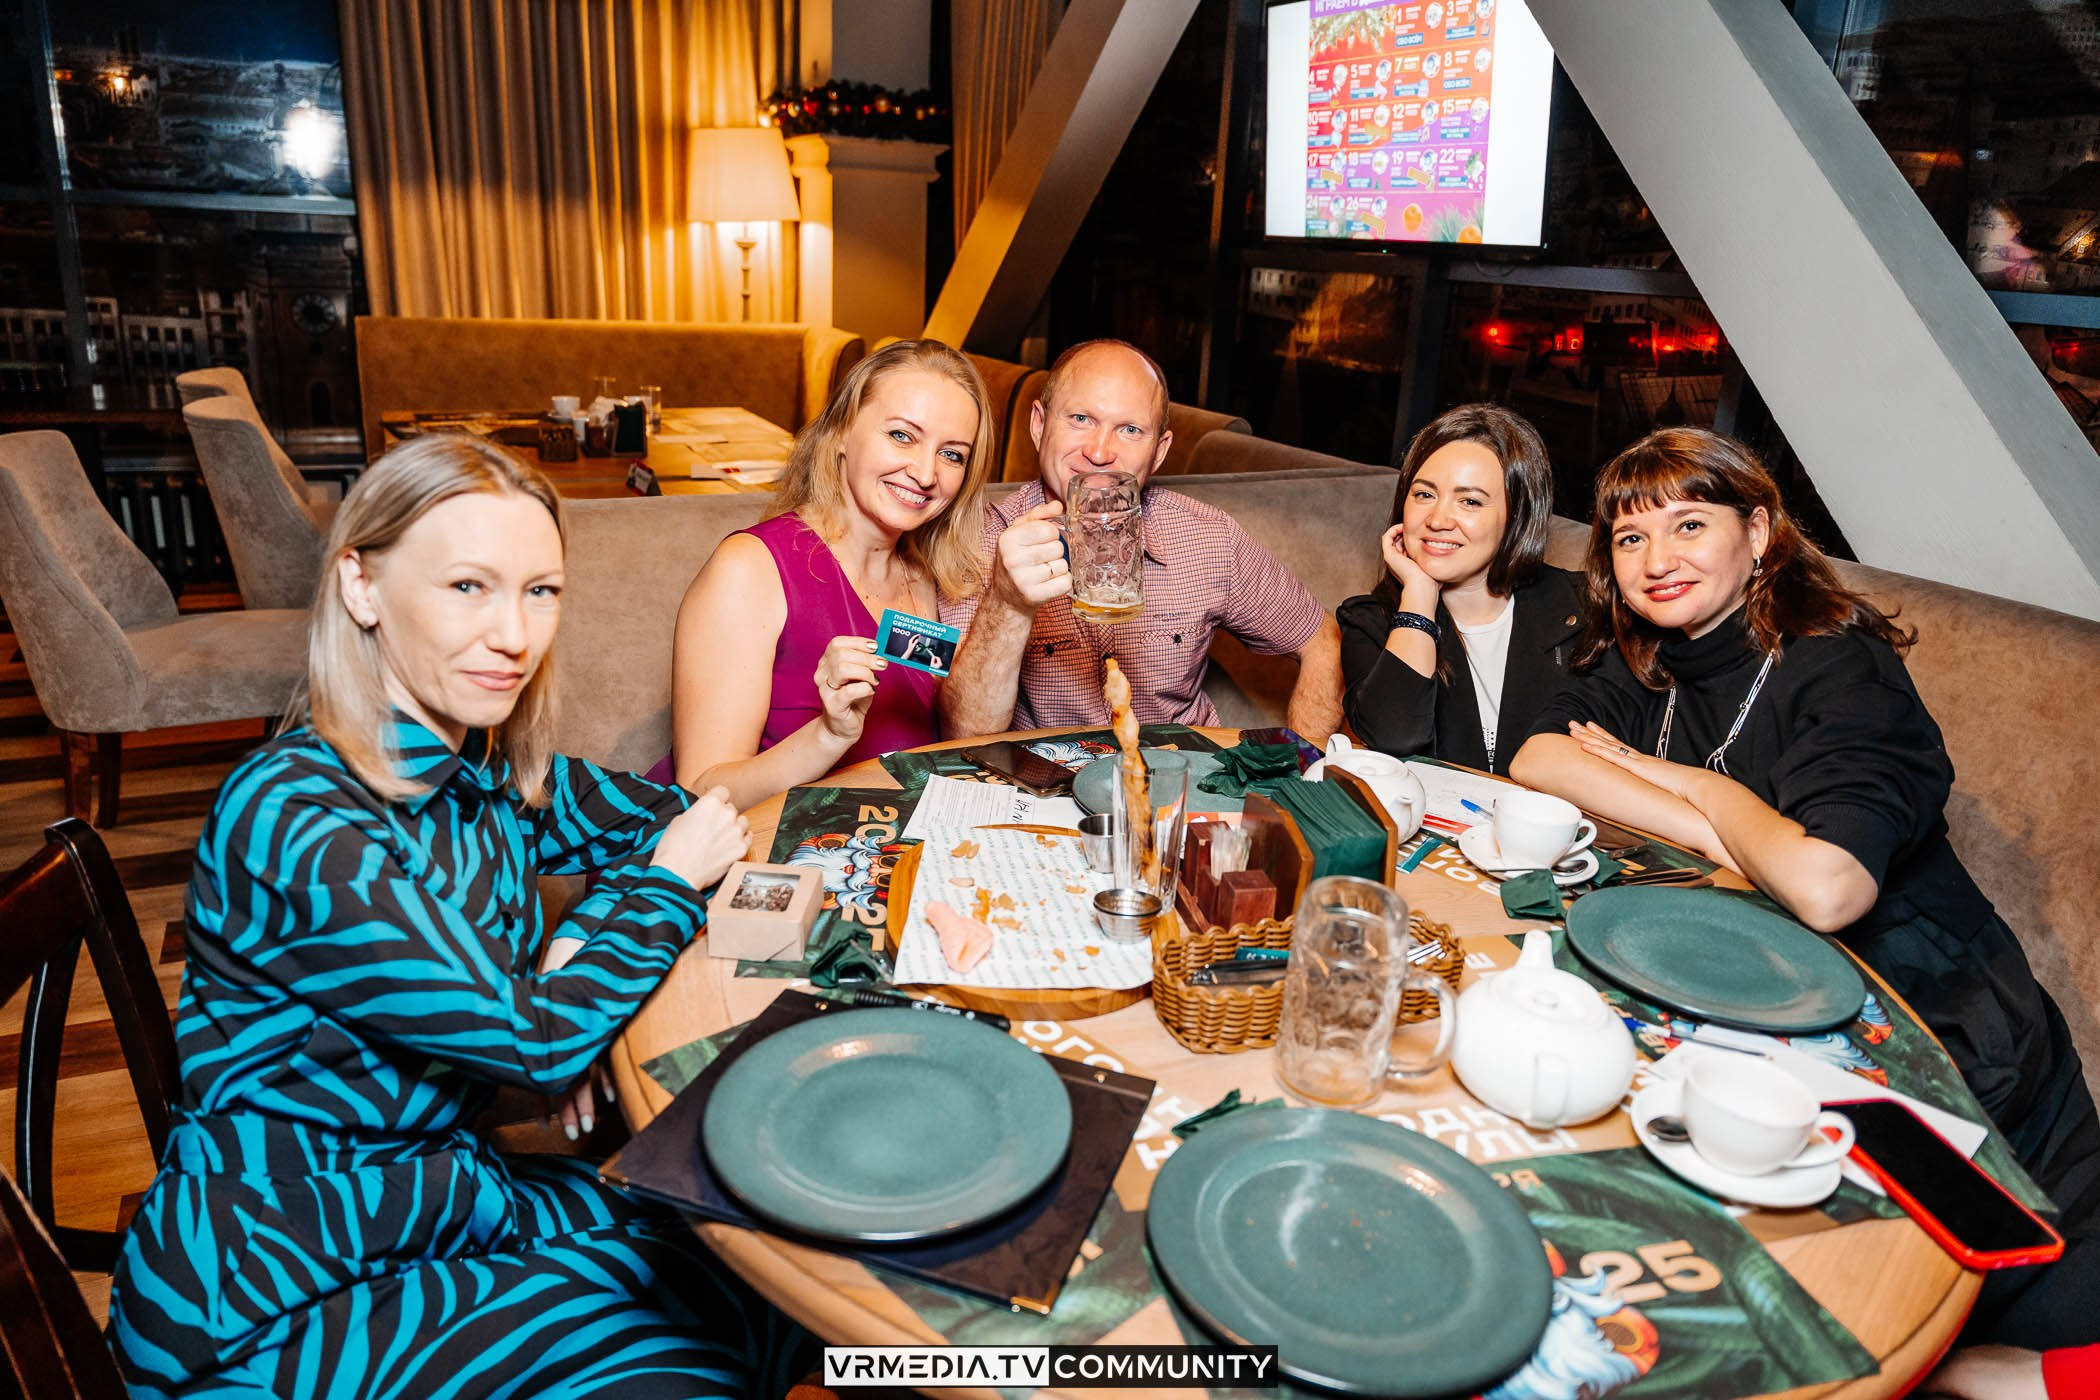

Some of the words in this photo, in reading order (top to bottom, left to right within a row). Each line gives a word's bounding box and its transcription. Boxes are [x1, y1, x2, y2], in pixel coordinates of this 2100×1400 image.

[1396, 7, 1402, 24] 1
[1446, 1, 1454, 17] 3
[1395, 57, 1403, 73] 7
[1444, 51, 1453, 67] 8
[1350, 64, 1358, 78] 5
[1392, 103, 1404, 119] 12
[1442, 98, 1455, 115] 15
[1308, 111, 1319, 125] 10
[1350, 108, 1359, 122] 11
[1308, 153, 1319, 168] 17
[1348, 152, 1359, 166] 18
[1392, 150, 1404, 165] 19
[1439, 148, 1455, 164] 22
[1346, 196, 1359, 210] 26
[892, 620, 943, 638] СЕРТИФИКАТ
[894, 614, 947, 633] ПОДАРОЧНЫЙ
[892, 627, 911, 637] 1000
[1580, 1239, 1723, 1305] 25
